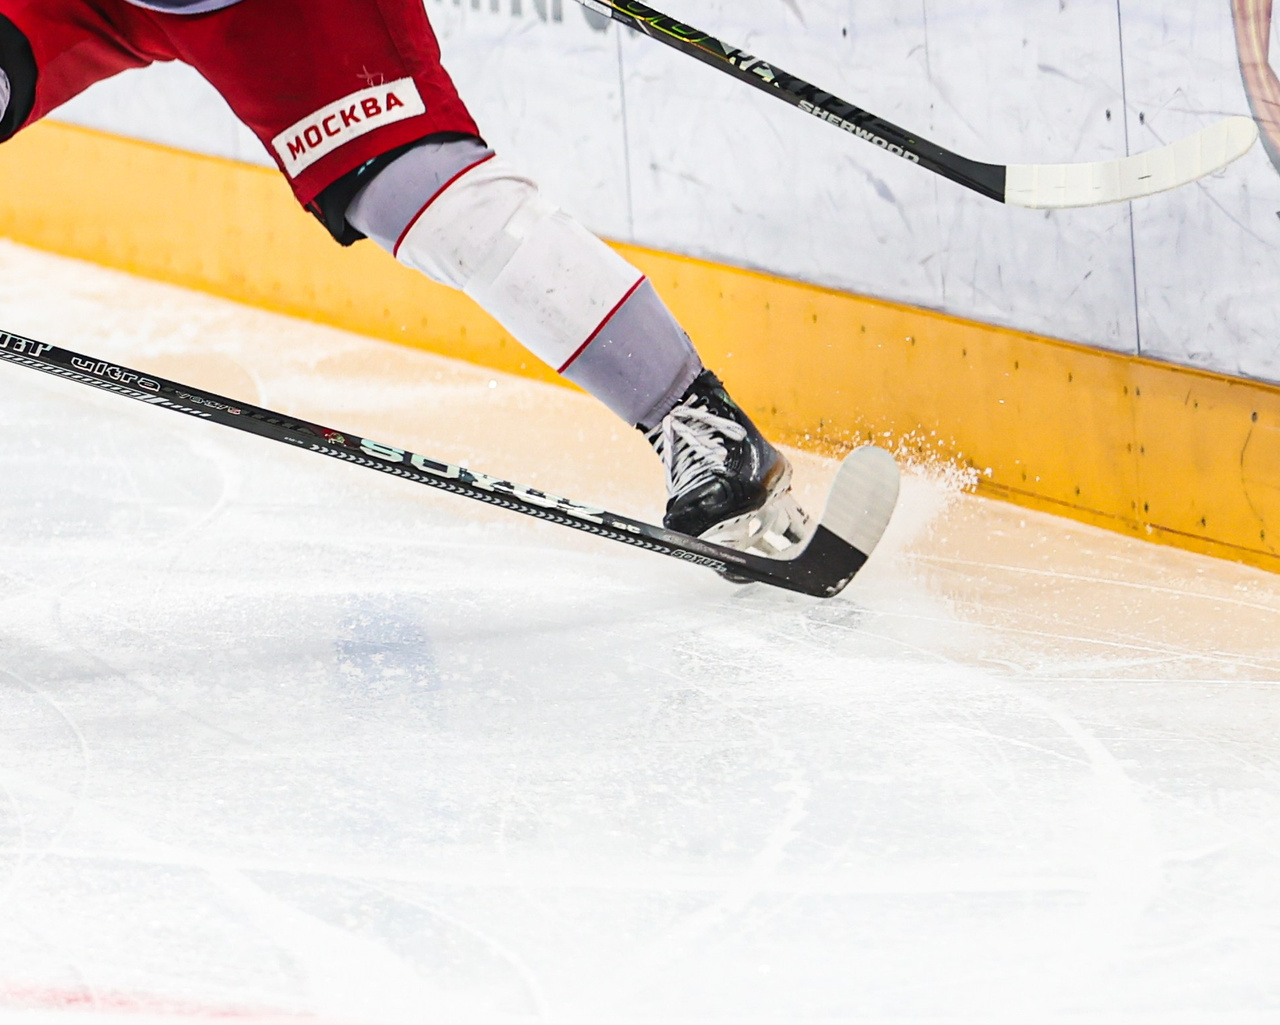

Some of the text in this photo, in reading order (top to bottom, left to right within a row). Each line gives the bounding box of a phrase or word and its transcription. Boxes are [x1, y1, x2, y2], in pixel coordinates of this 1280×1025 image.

[286, 92, 405, 161] МОСКВА
[797, 98, 920, 164] SHERWOOD
[671, 548, 726, 571] SOYUZ
